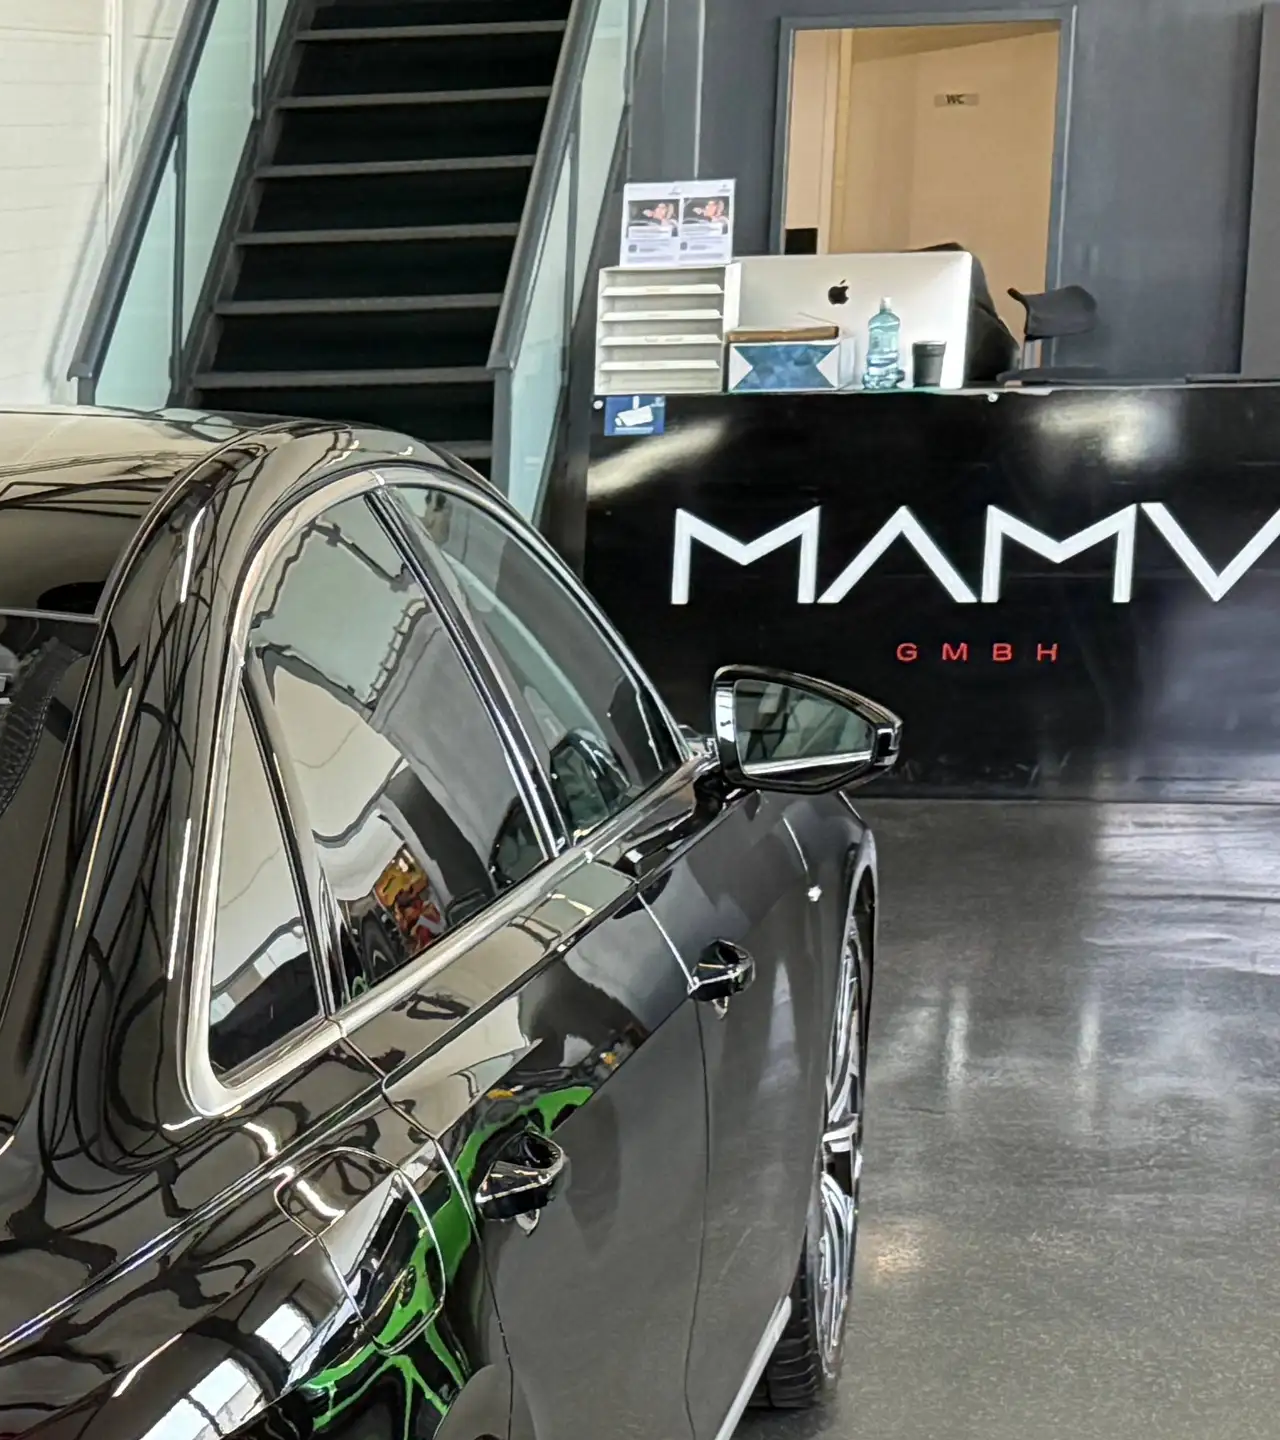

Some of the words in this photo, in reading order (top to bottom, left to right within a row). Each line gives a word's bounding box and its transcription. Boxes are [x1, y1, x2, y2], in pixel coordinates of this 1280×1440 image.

[945, 93, 965, 105] WC
[671, 502, 1280, 605] MAMV
[896, 641, 1059, 663] GMBH
